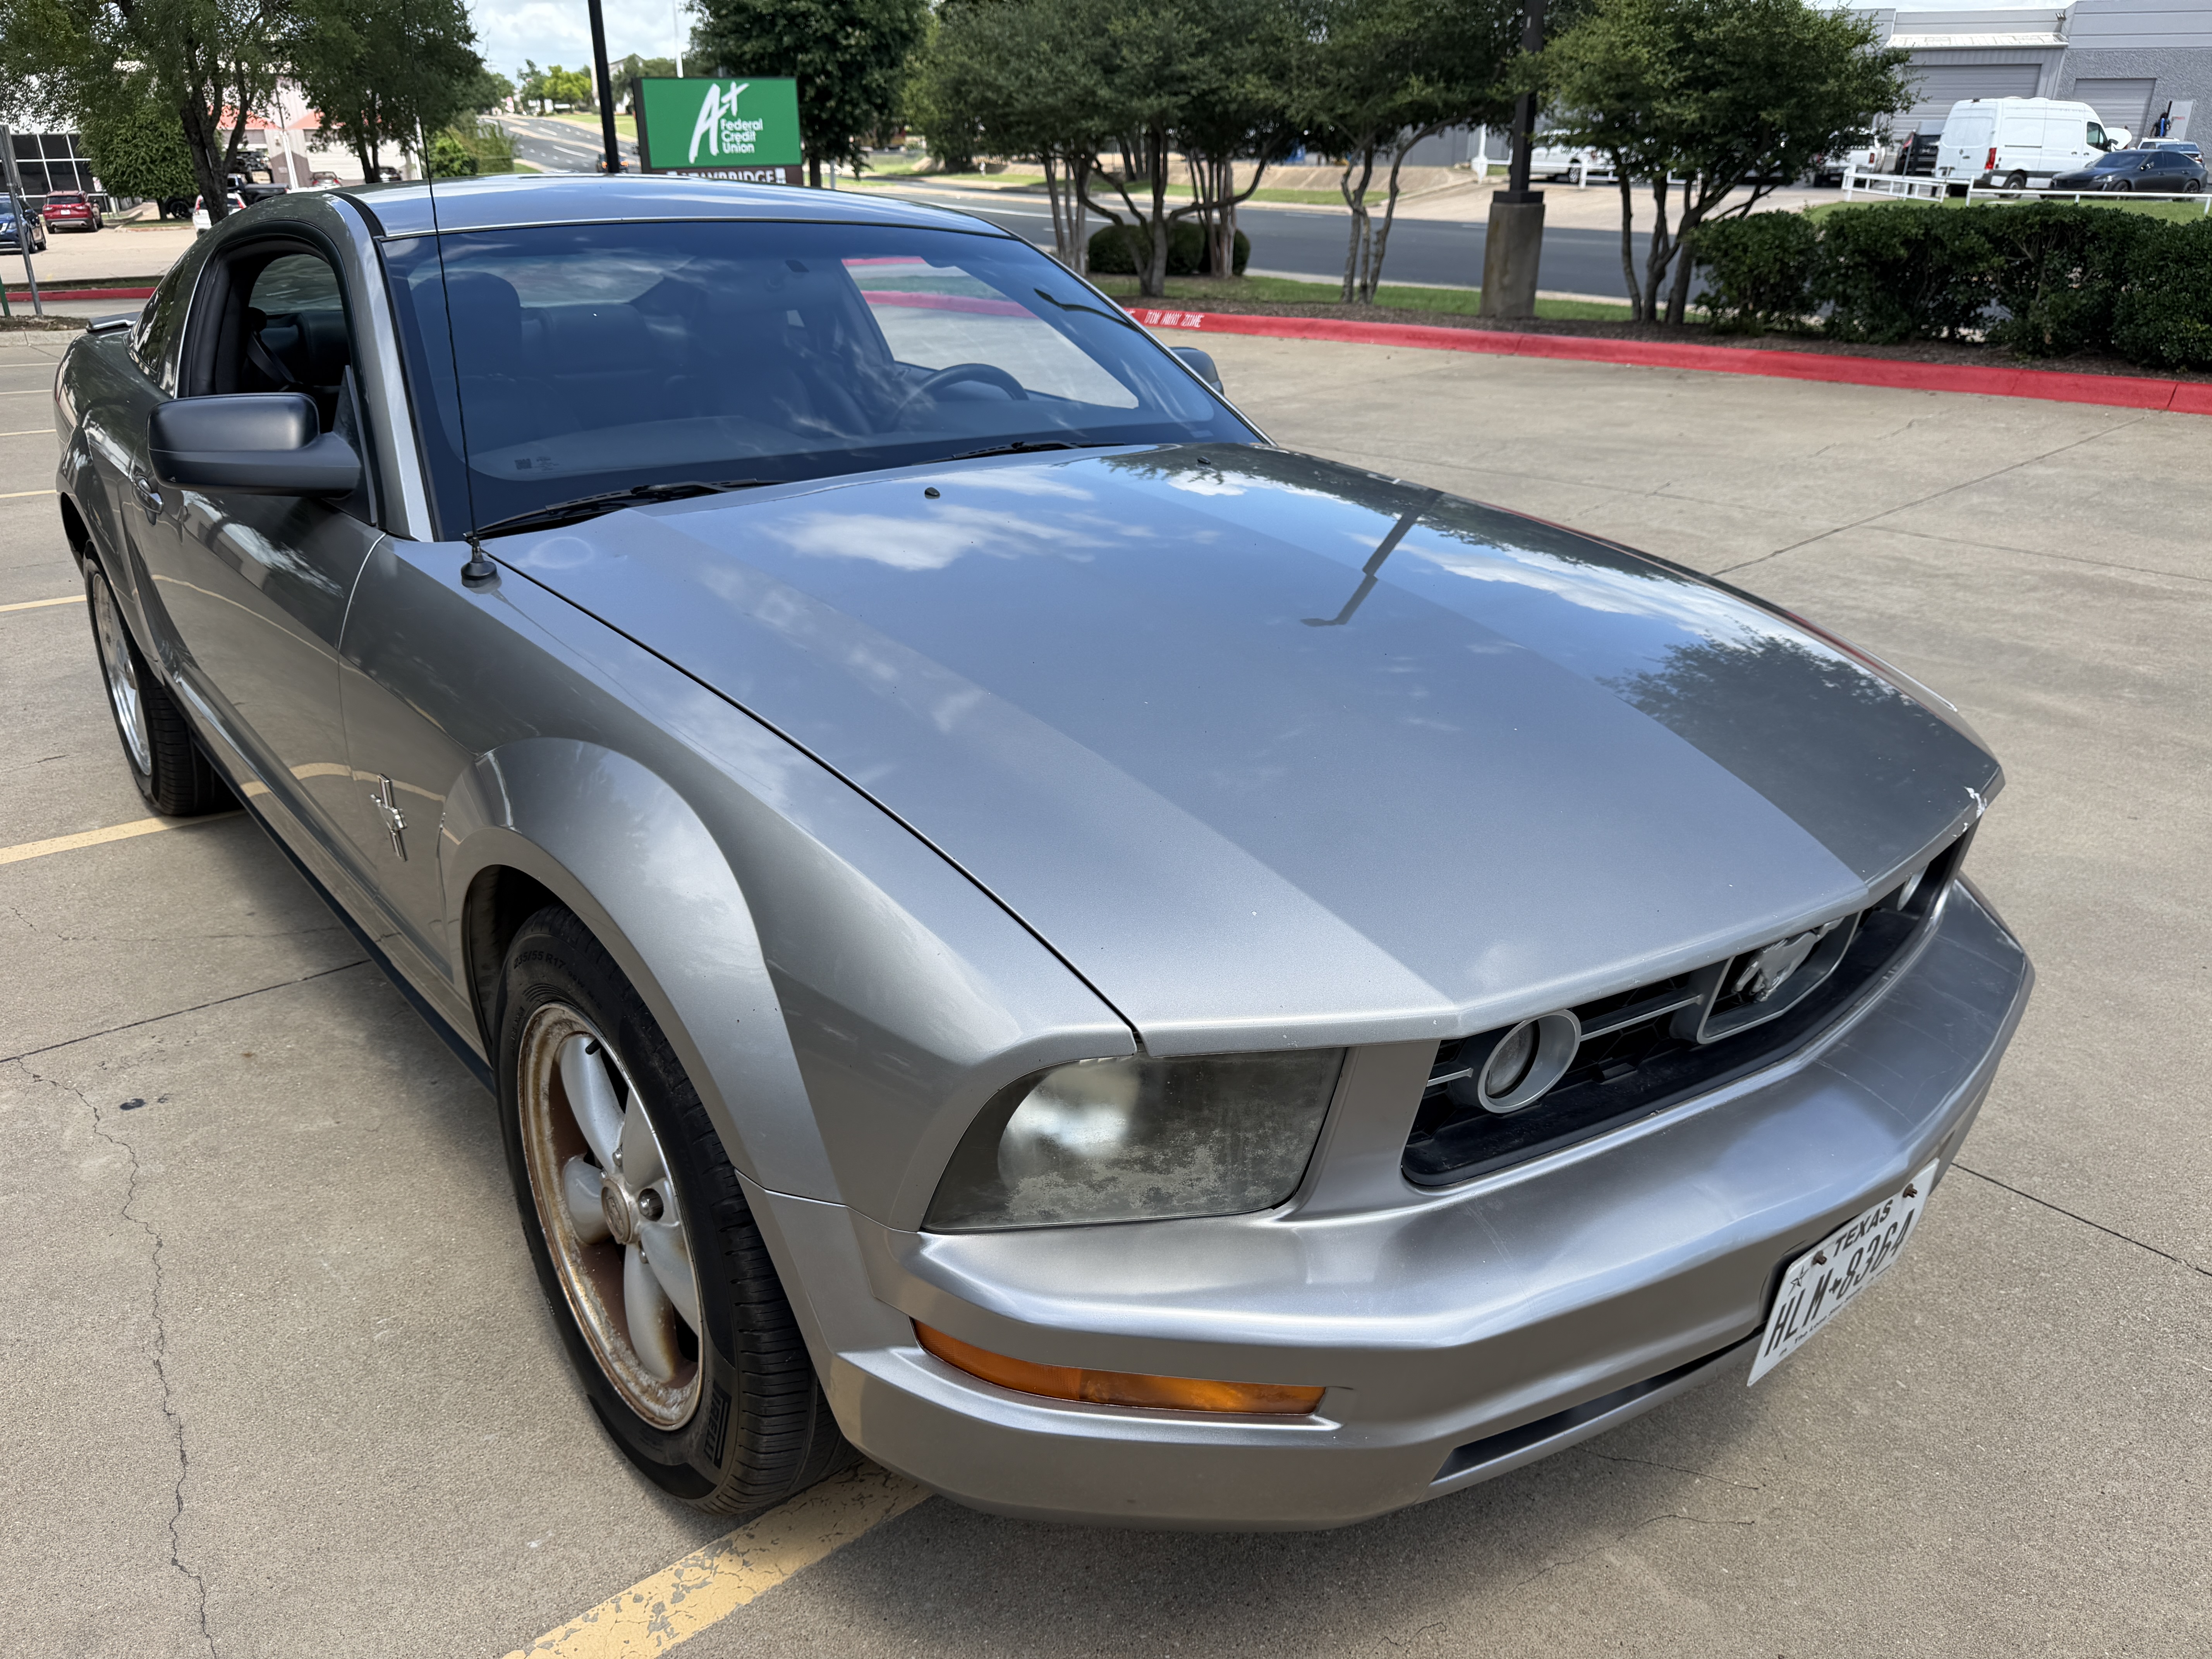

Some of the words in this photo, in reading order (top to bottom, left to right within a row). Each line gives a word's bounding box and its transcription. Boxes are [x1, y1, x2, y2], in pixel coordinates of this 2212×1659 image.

[720, 118, 763, 131] Federal
[721, 130, 756, 143] Credit
[722, 142, 755, 154] Union
[1144, 310, 1162, 325] TOW
[1180, 313, 1205, 328] ZONE
[514, 950, 544, 969] 235/55
[546, 953, 566, 969] R17
[1833, 1199, 1894, 1257] TEXAS
